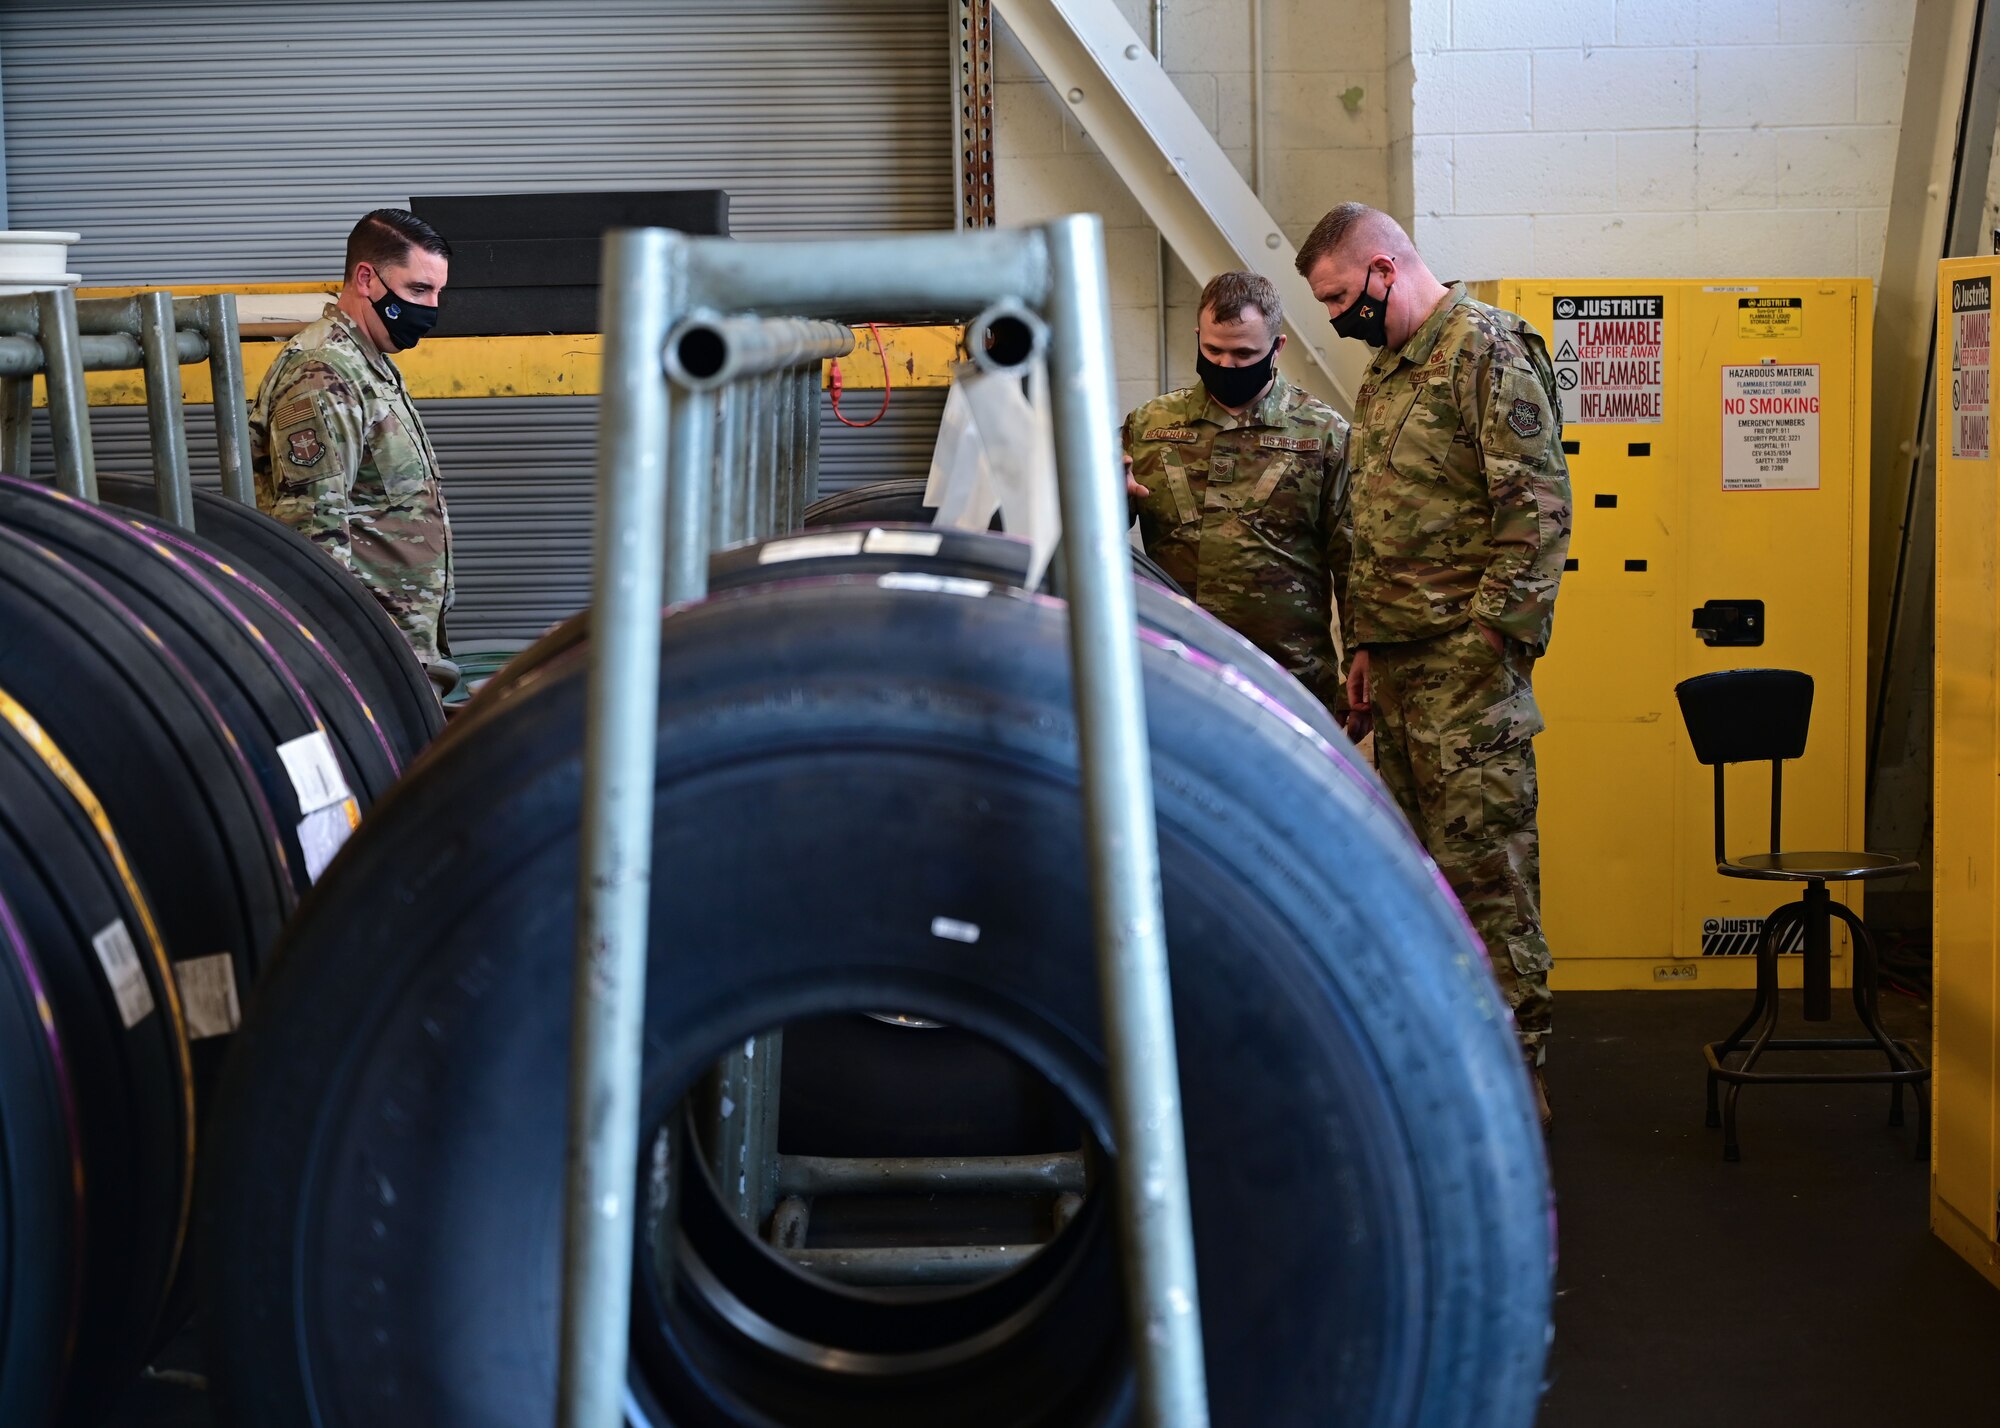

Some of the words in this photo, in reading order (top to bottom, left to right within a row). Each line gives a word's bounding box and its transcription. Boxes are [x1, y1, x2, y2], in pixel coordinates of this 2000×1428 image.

[1961, 282, 1989, 307] Justrite
[1578, 300, 1656, 317] JUSTRITE
[1757, 299, 1791, 307] JUSTRITE
[1578, 321, 1661, 346] FLAMMABLE
[1961, 312, 1990, 348] FLAMMABLE
[1578, 346, 1604, 359] KEEP
[1606, 346, 1628, 359] FIRE
[1630, 346, 1660, 359] AWAY
[1581, 361, 1661, 385] INFLAMABLE
[1729, 368, 1775, 378] HAZARDOUS
[1777, 368, 1814, 377] MATERIAL
[1581, 393, 1661, 417] INFLAMMABLE
[1725, 398, 1745, 415] NO
[1749, 397, 1819, 415] SMOKING
[1738, 419, 1774, 427] EMERGENCY
[1146, 429, 1195, 440] BEAUCHAMP
[1277, 437, 1290, 448] AIR
[1292, 440, 1317, 450] FORCE
[1721, 918, 1765, 933] JUSTR
